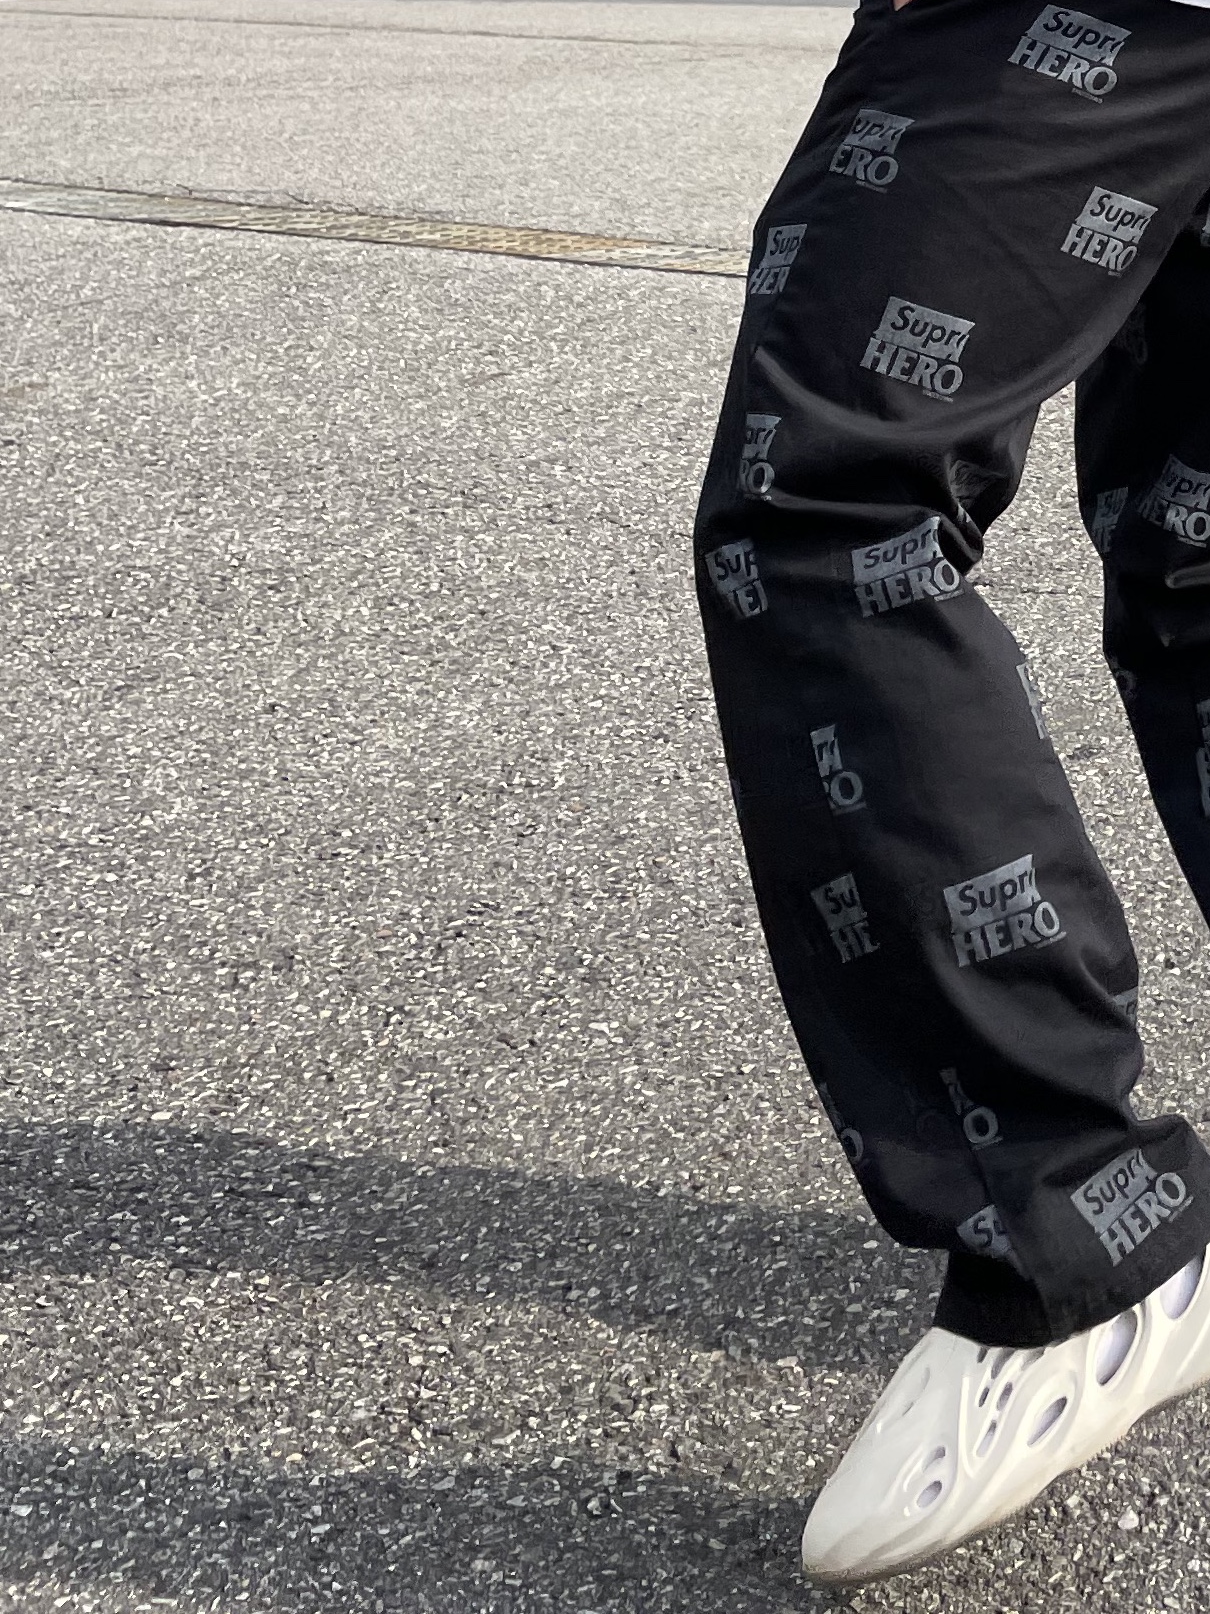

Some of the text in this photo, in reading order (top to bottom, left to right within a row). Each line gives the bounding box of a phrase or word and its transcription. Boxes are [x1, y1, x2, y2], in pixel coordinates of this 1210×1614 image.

[1007, 35, 1118, 95] HERO
[830, 143, 899, 186] ERO
[1060, 223, 1138, 272] HERO
[860, 337, 963, 395] HERO
[855, 557, 960, 618] HERO
[952, 901, 1060, 967] HERO
[1099, 1172, 1186, 1266] HERO
